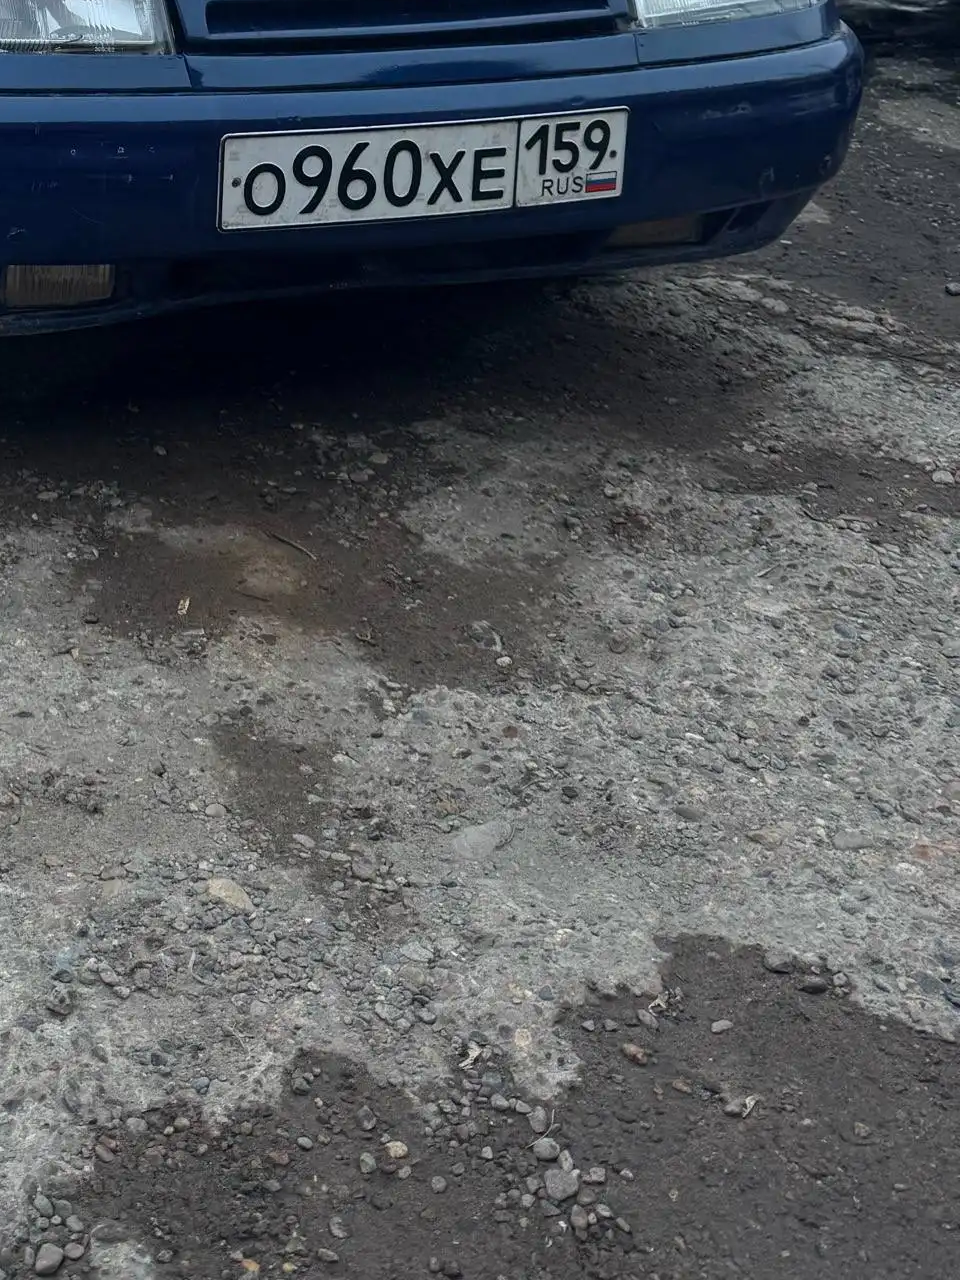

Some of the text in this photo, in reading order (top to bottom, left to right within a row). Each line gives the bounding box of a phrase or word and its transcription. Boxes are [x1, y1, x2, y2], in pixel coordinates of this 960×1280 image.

[243, 119, 611, 215] О960ХЕ 159
[541, 176, 583, 197] RUS
